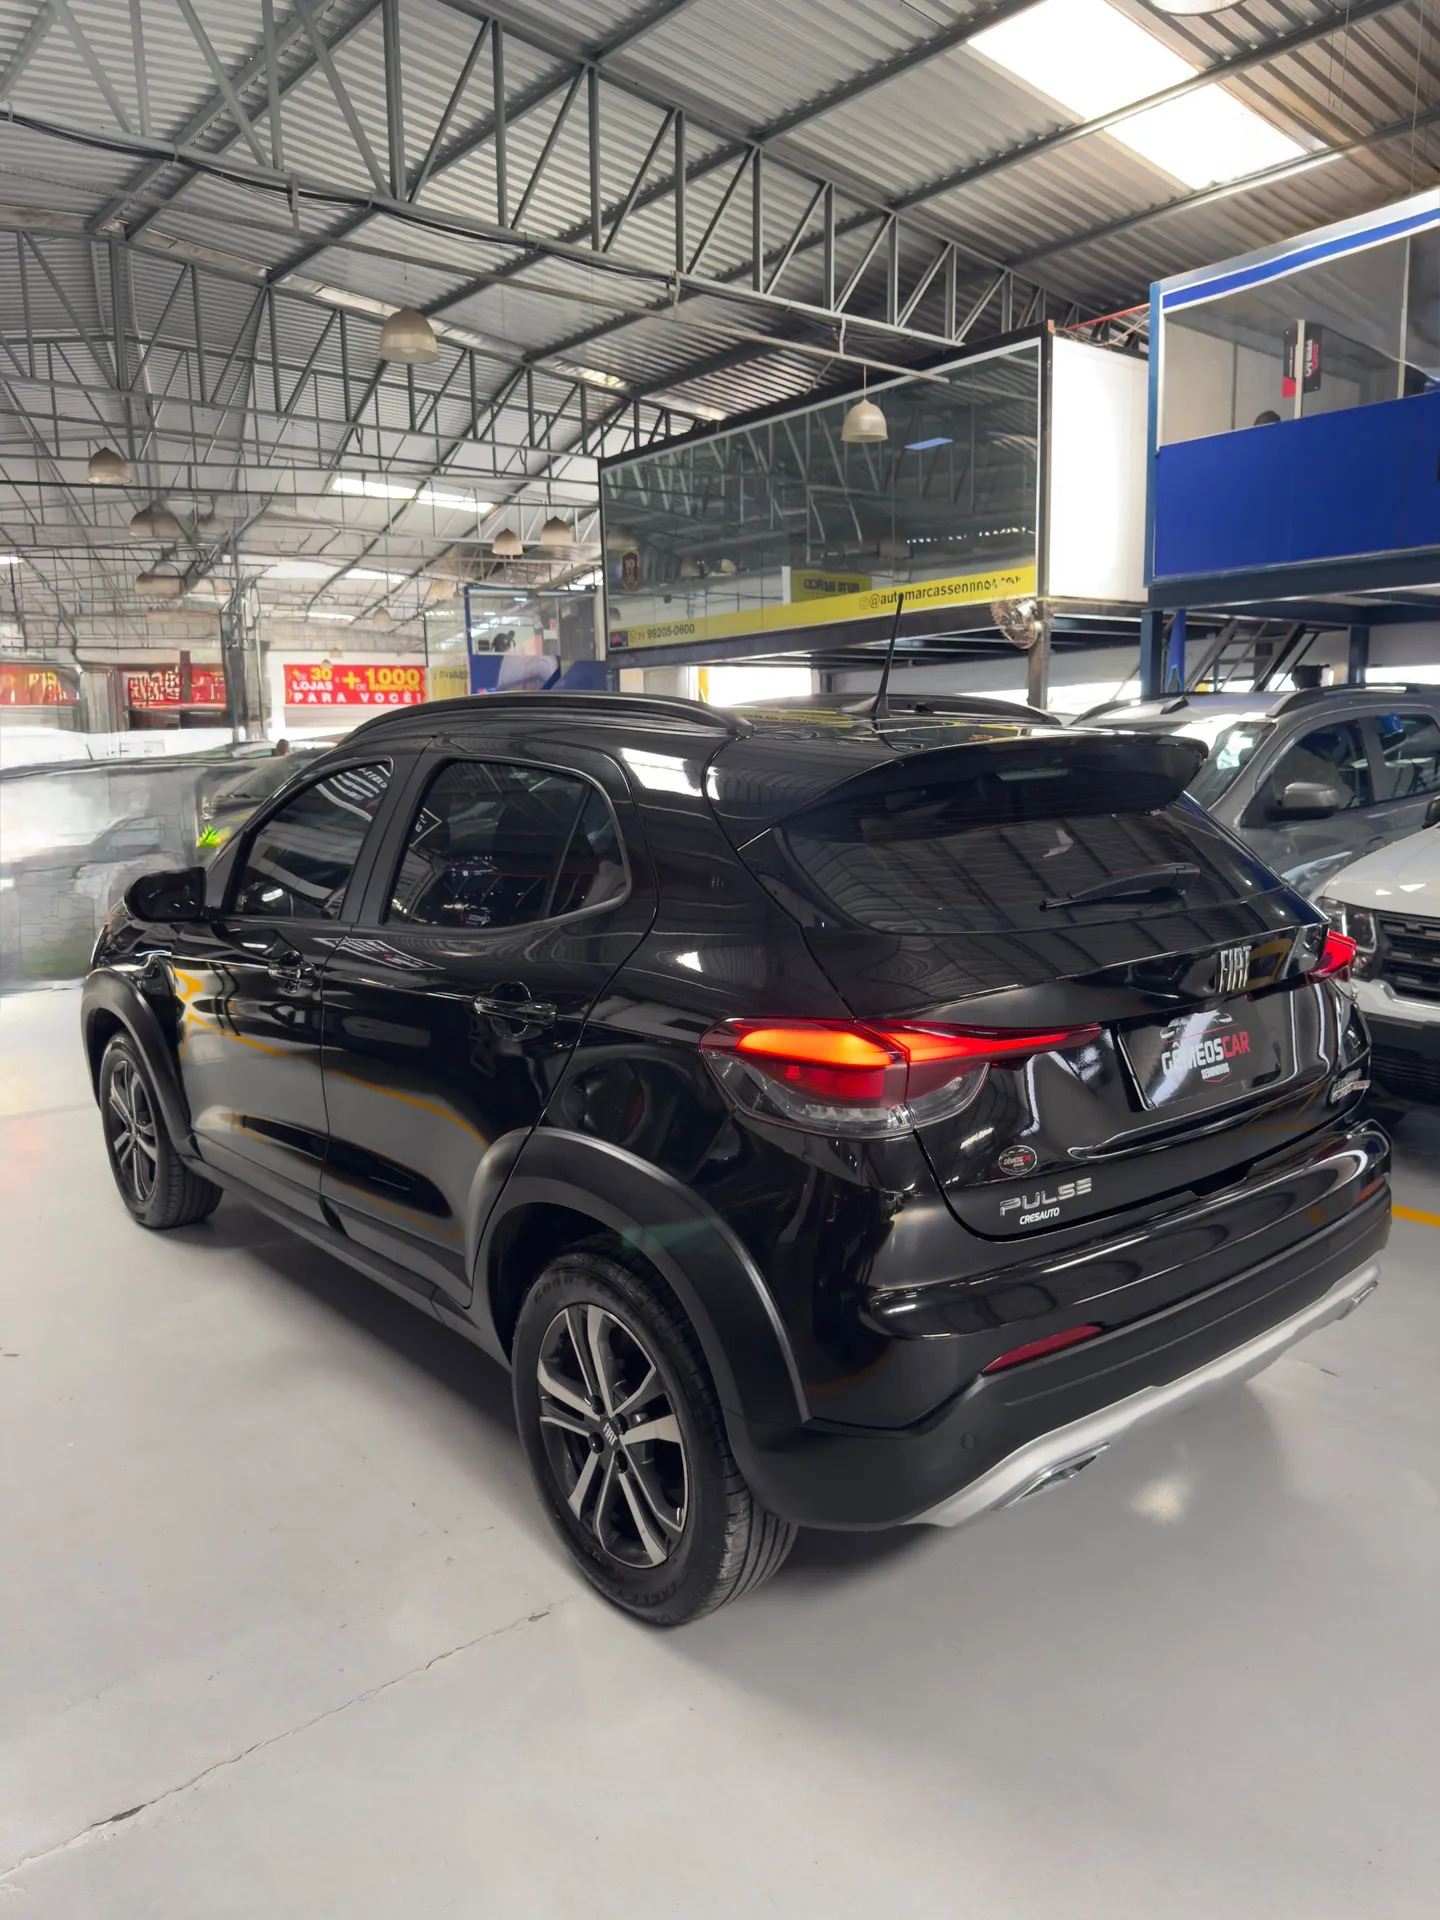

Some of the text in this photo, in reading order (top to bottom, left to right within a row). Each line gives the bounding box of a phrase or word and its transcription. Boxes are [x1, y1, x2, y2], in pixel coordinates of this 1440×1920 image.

[310, 667, 333, 681] 30
[365, 668, 419, 685] 1000
[292, 681, 333, 691] LOJAS
[294, 692, 347, 703] PARA
[1219, 945, 1252, 993] FIAT
[1000, 1177, 1092, 1216] PULSE
[1019, 1207, 1060, 1225] CRESAUTO
[603, 1421, 618, 1447] FIAT
